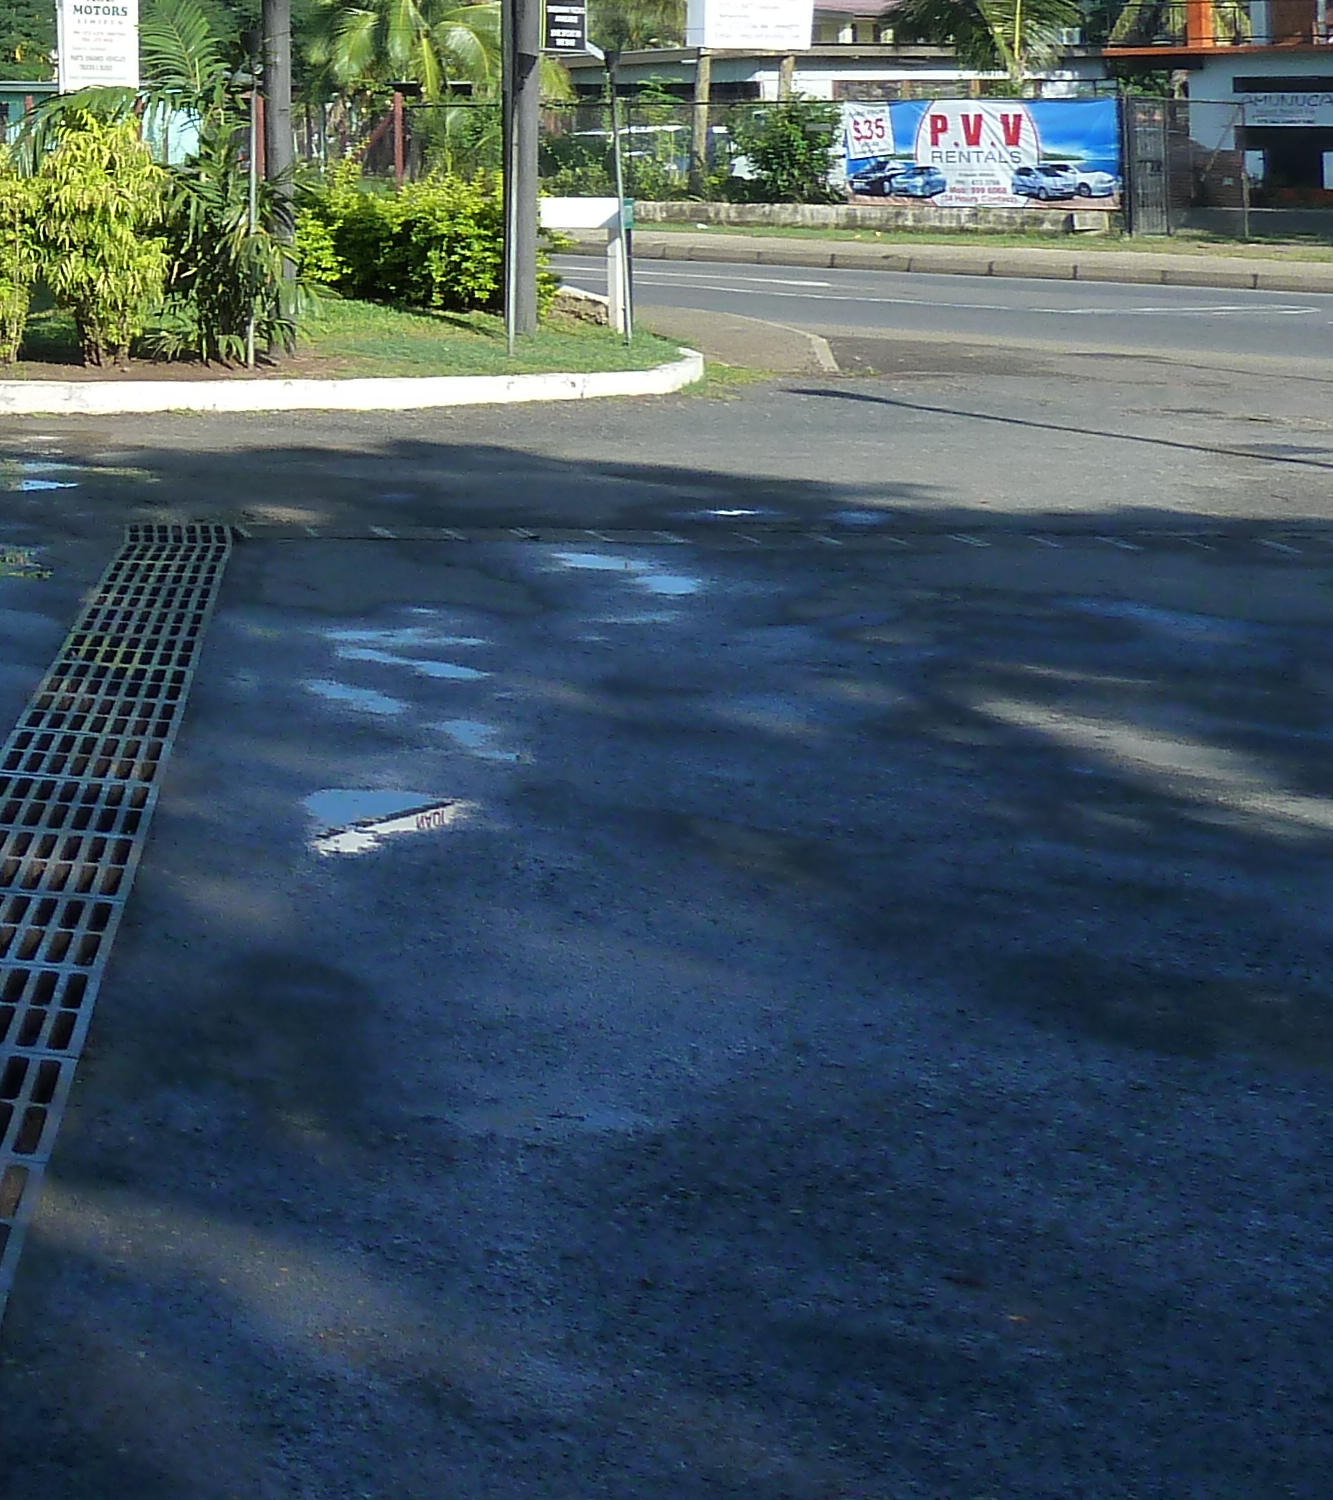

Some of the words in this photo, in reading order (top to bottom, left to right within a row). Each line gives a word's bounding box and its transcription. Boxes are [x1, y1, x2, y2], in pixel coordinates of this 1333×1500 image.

[72, 4, 128, 16] MOTORS
[852, 117, 886, 141] $35
[931, 150, 1022, 163] RENTALS
